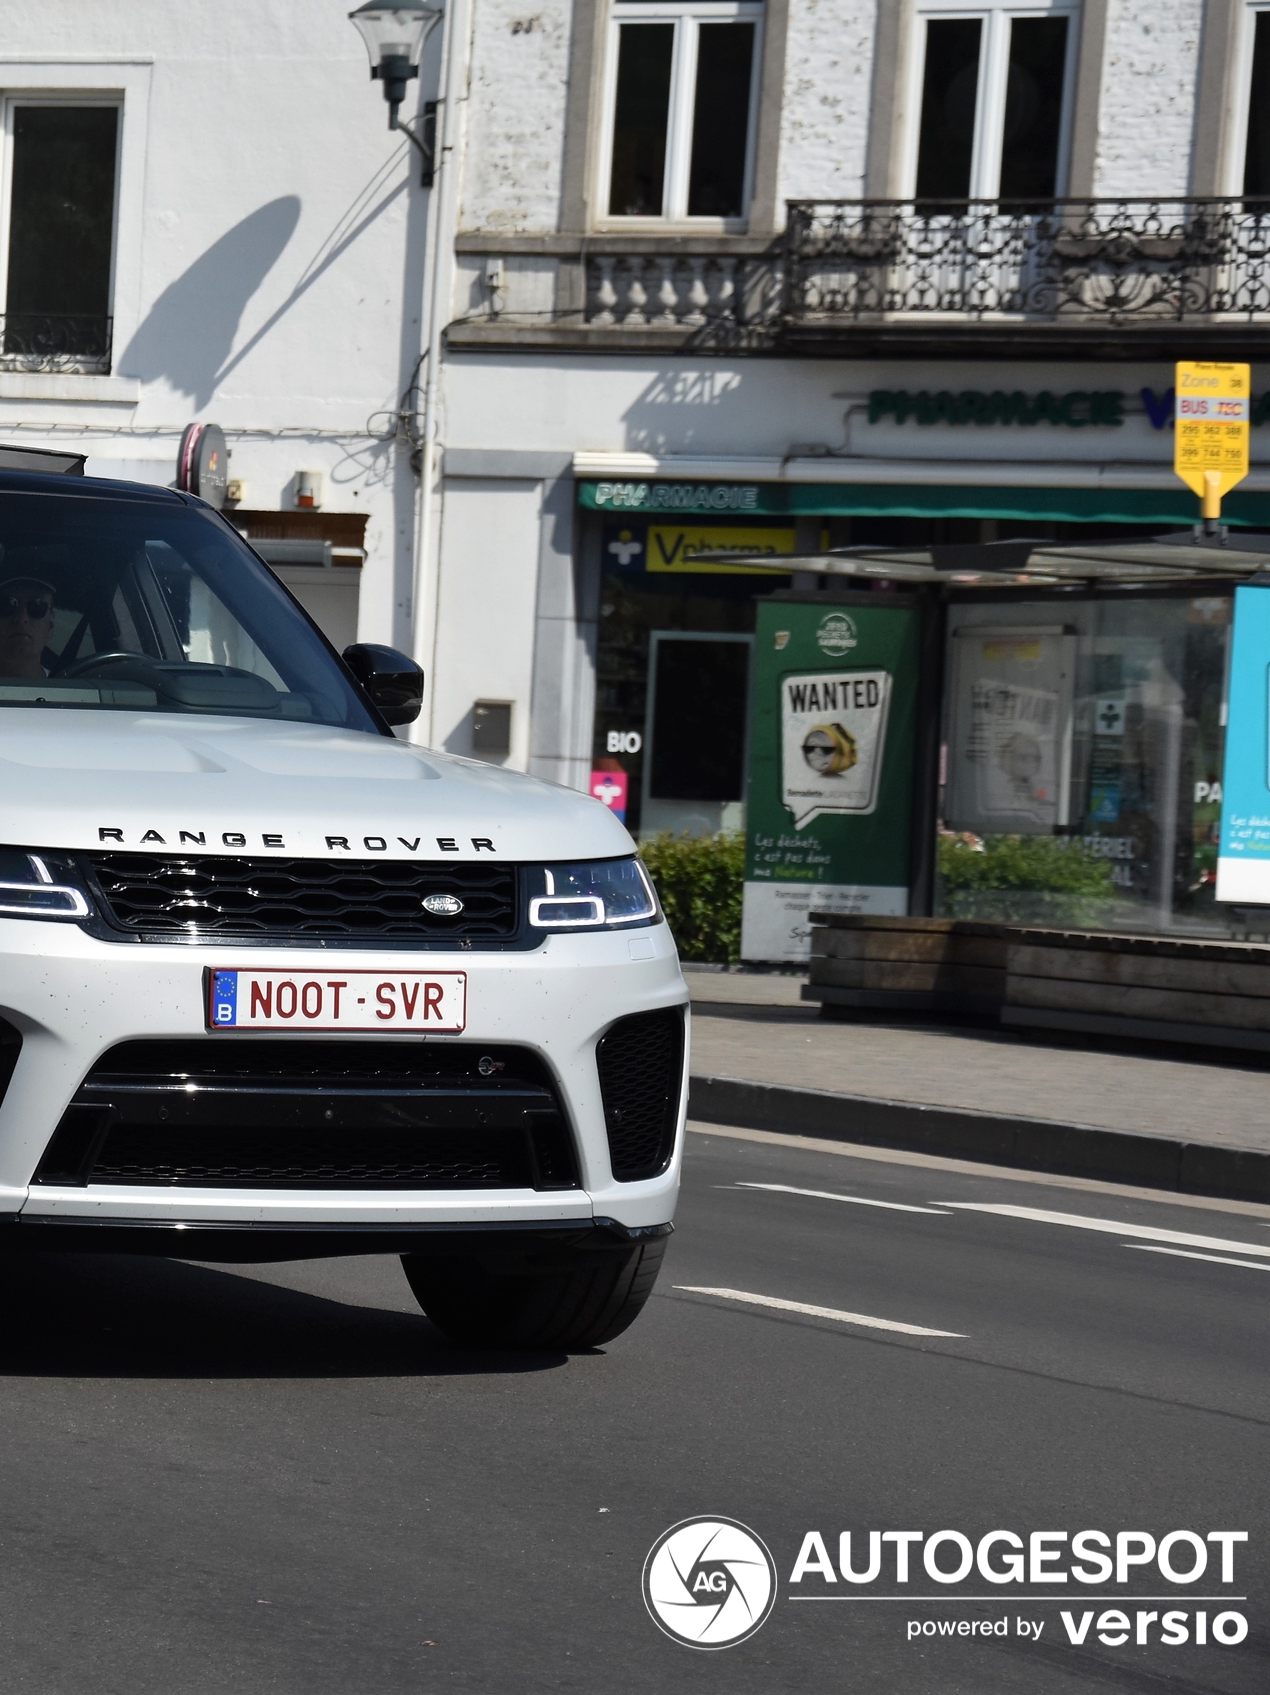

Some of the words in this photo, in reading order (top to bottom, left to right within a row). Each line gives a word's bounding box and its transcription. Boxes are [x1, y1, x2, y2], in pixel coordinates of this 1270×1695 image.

[1181, 373, 1219, 388] Zone
[868, 390, 1124, 427] PHARMACIE
[1181, 400, 1208, 415] BUS
[1216, 401, 1243, 416] TEC
[594, 482, 759, 509] PHARMACIE
[788, 679, 879, 713] WANTED
[607, 731, 642, 753] BIO
[98, 827, 286, 849] RANGE
[324, 836, 497, 852] ROVER
[217, 1004, 232, 1022] B
